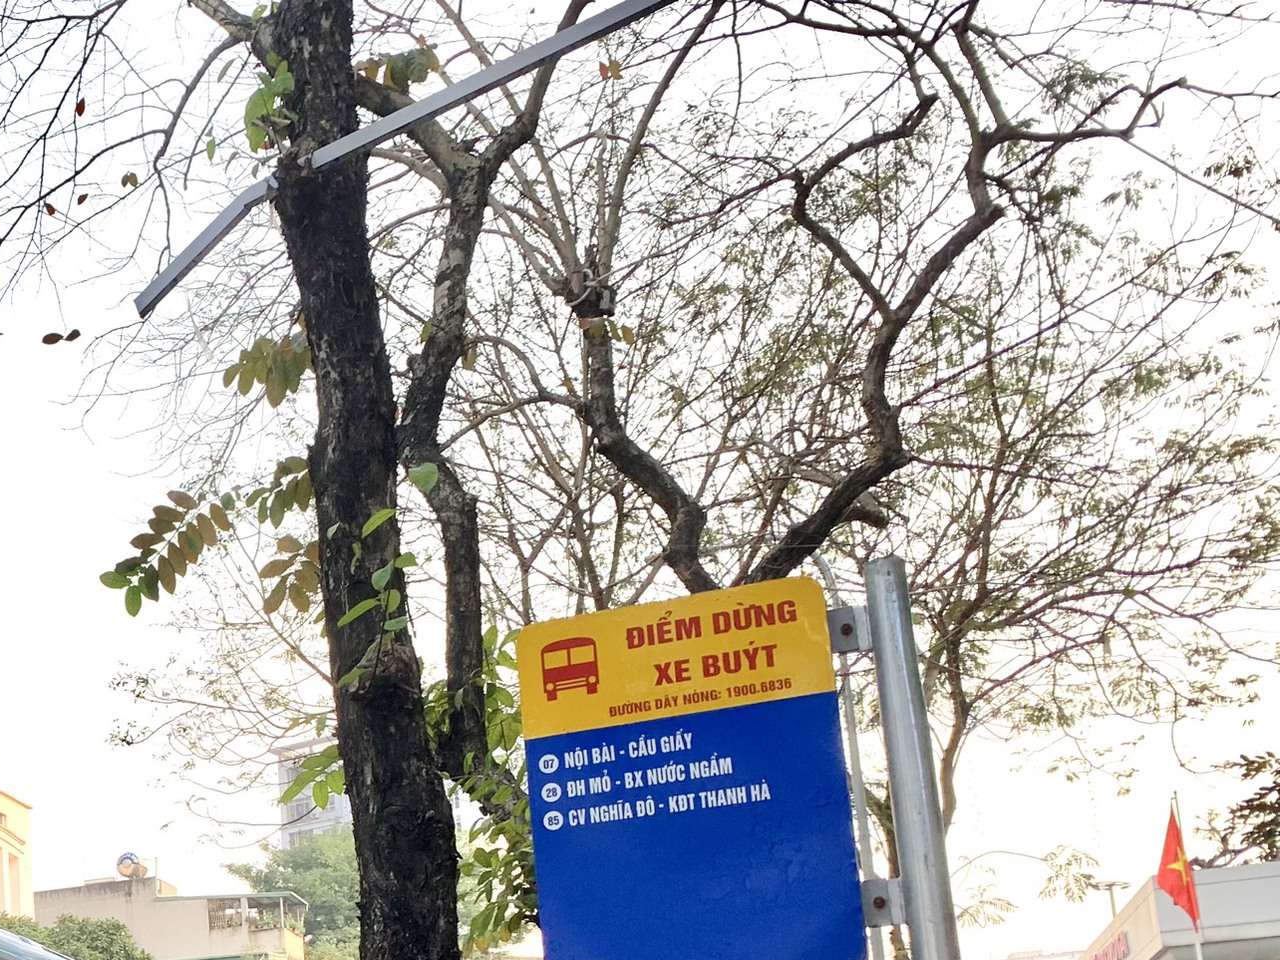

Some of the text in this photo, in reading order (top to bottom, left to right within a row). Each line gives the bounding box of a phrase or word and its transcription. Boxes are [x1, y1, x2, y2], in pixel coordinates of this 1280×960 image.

[626, 600, 797, 650] ĐIỂM DỪNG
[653, 640, 777, 686] XE BUÝT
[609, 678, 792, 717] ĐƯỜNG DÂY NÓNG: 1900.6836
[543, 759, 554, 769] 07
[564, 747, 588, 770] NỘI
[592, 743, 615, 764] BÀI
[629, 735, 656, 758] CẦU
[661, 729, 692, 753] GIẤY
[546, 787, 557, 798] 28
[567, 781, 586, 798] ĐH
[589, 769, 611, 794] MỎ
[624, 770, 643, 789] BX
[647, 760, 686, 785] NƯỚC
[690, 752, 733, 778] NGẦM
[547, 816, 559, 826] 85
[568, 810, 586, 827] CV
[590, 800, 633, 824] NGHĨA
[636, 796, 655, 817] ĐÔ
[669, 793, 695, 813] KĐT
[699, 787, 752, 808] THANH
[751, 779, 771, 802] HÀ
